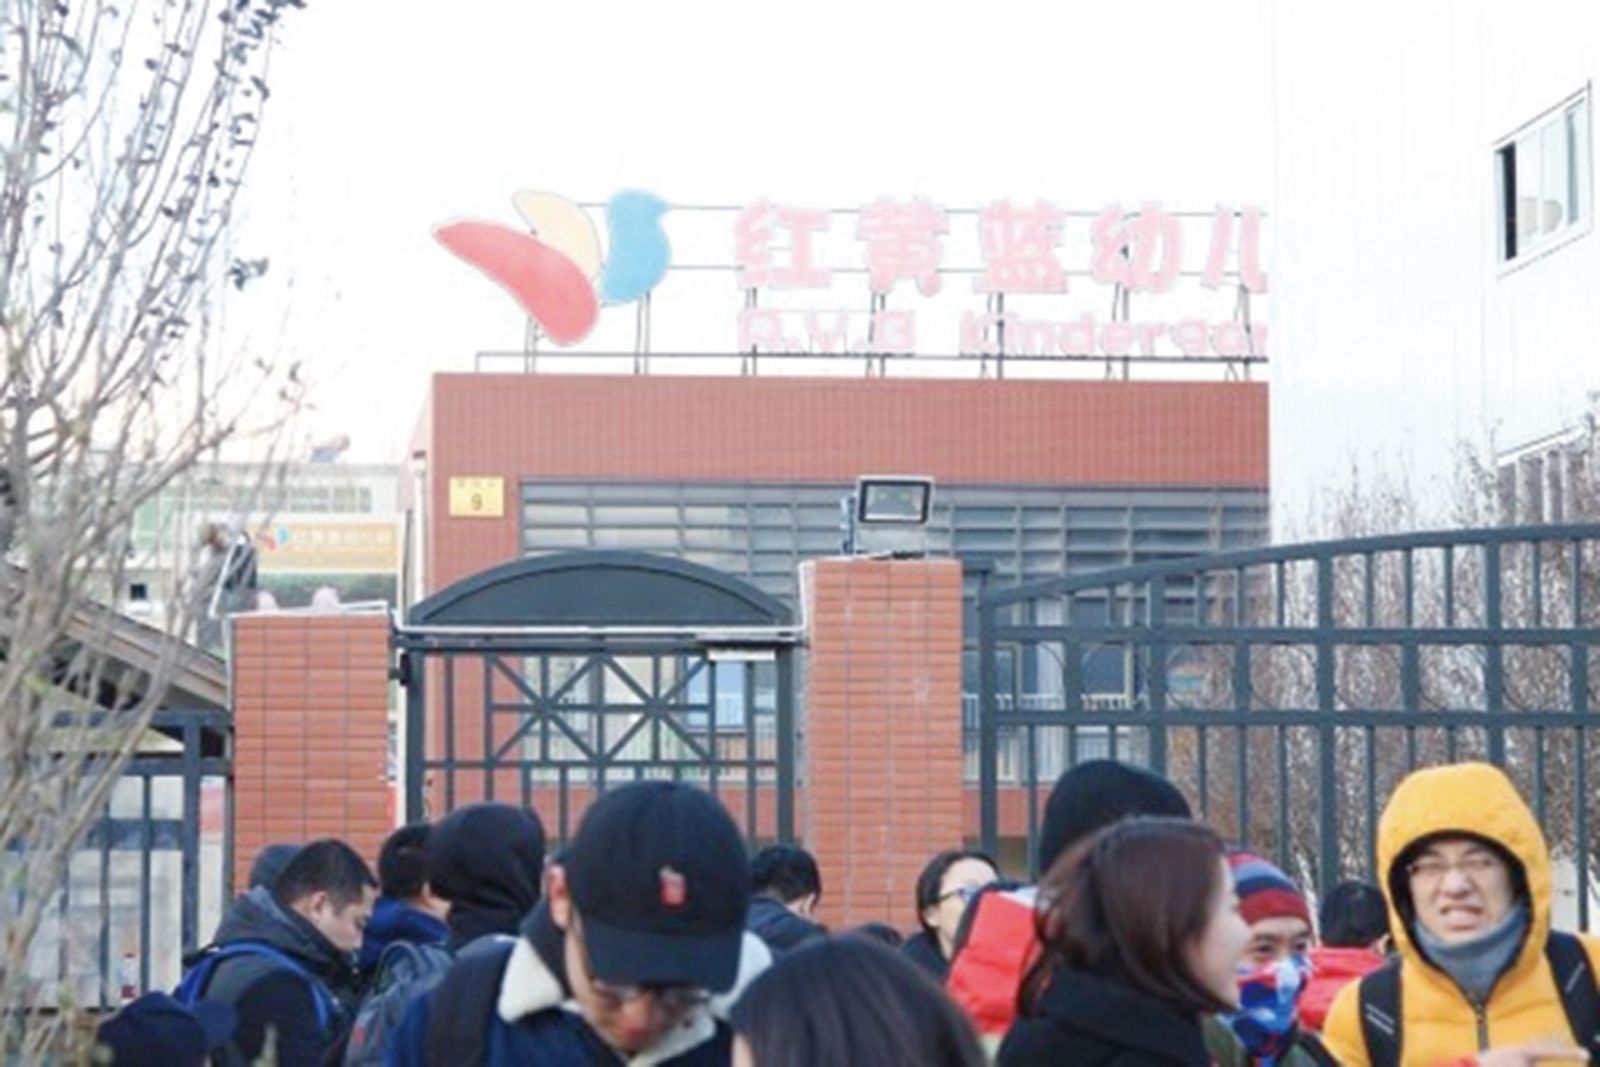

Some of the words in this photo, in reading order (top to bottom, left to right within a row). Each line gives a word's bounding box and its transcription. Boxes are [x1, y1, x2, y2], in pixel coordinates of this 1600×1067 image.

[734, 197, 1267, 295] 红黄蓝幼儿
[470, 493, 483, 510] 9
